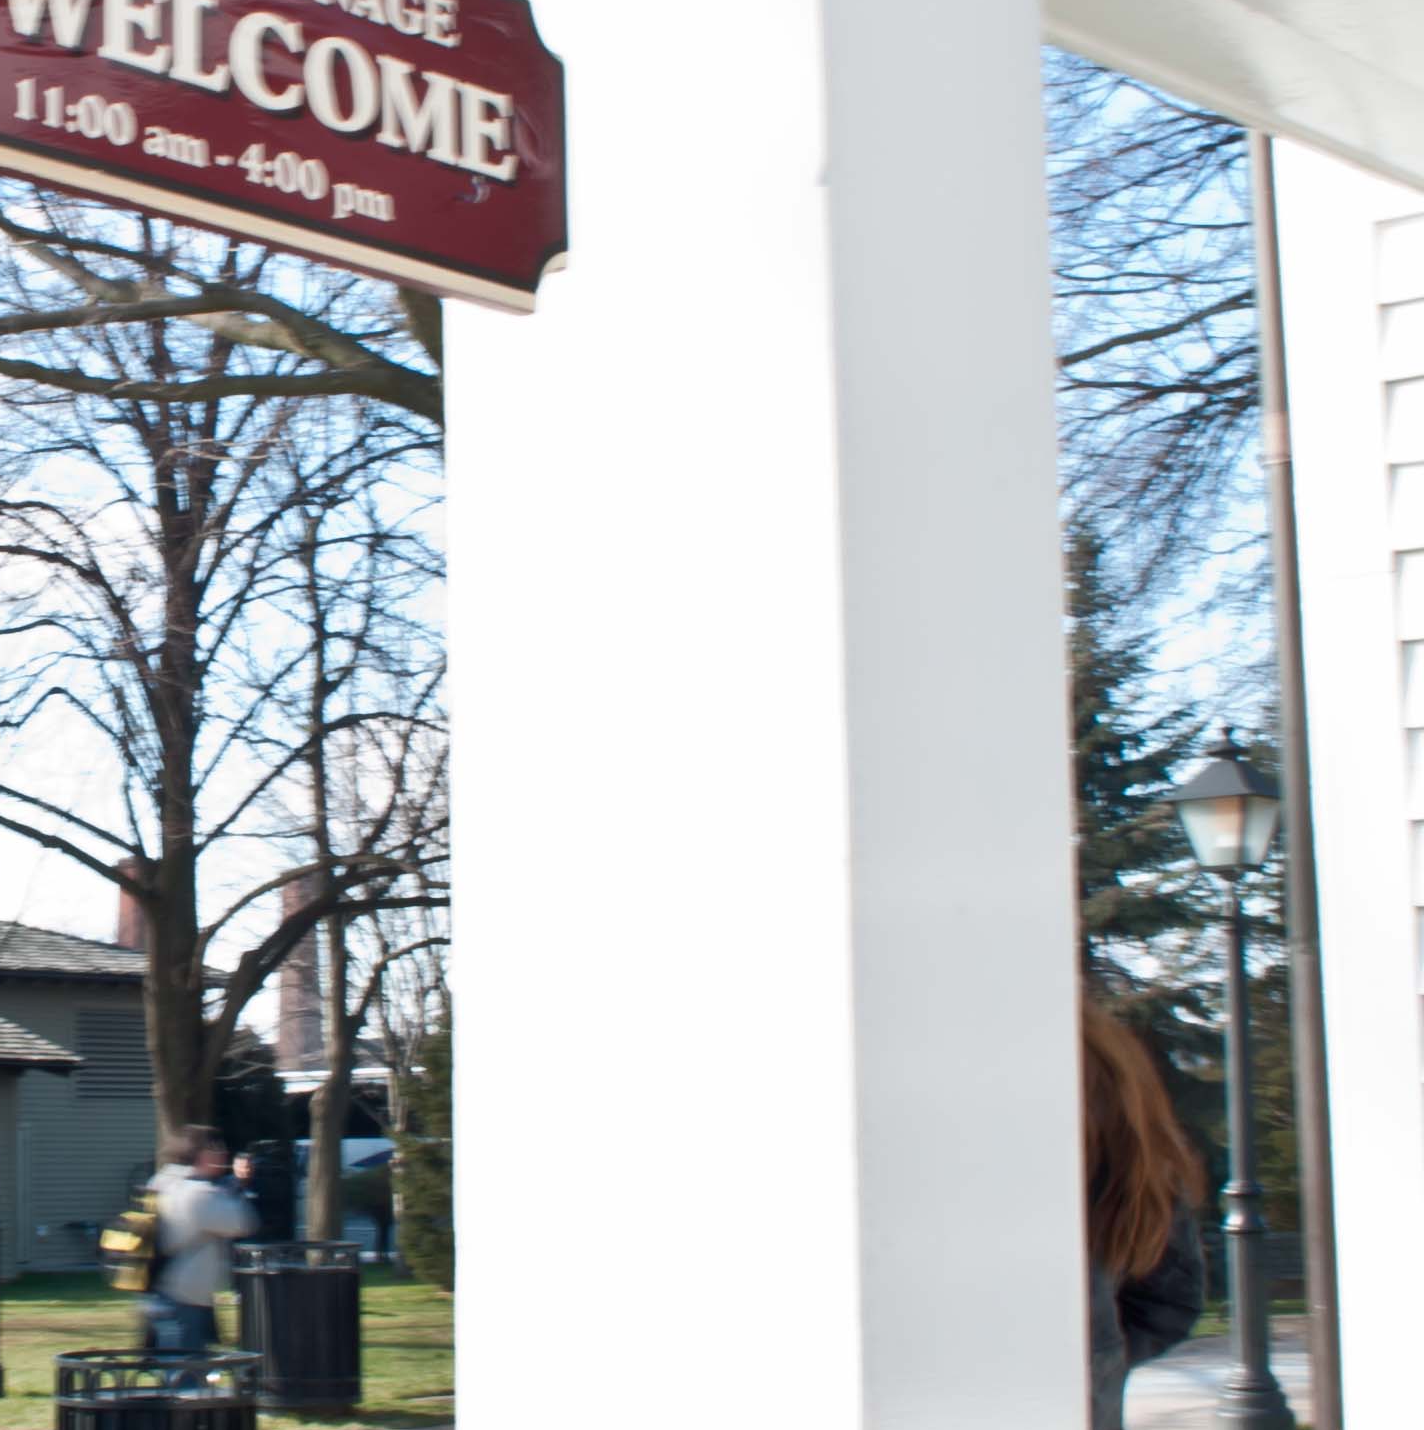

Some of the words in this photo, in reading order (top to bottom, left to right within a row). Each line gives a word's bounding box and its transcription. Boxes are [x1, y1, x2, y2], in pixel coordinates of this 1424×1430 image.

[13, 77, 137, 147] 11:00
[143, 123, 210, 168] am
[235, 142, 330, 201] 4:00
[332, 182, 395, 223] pm
